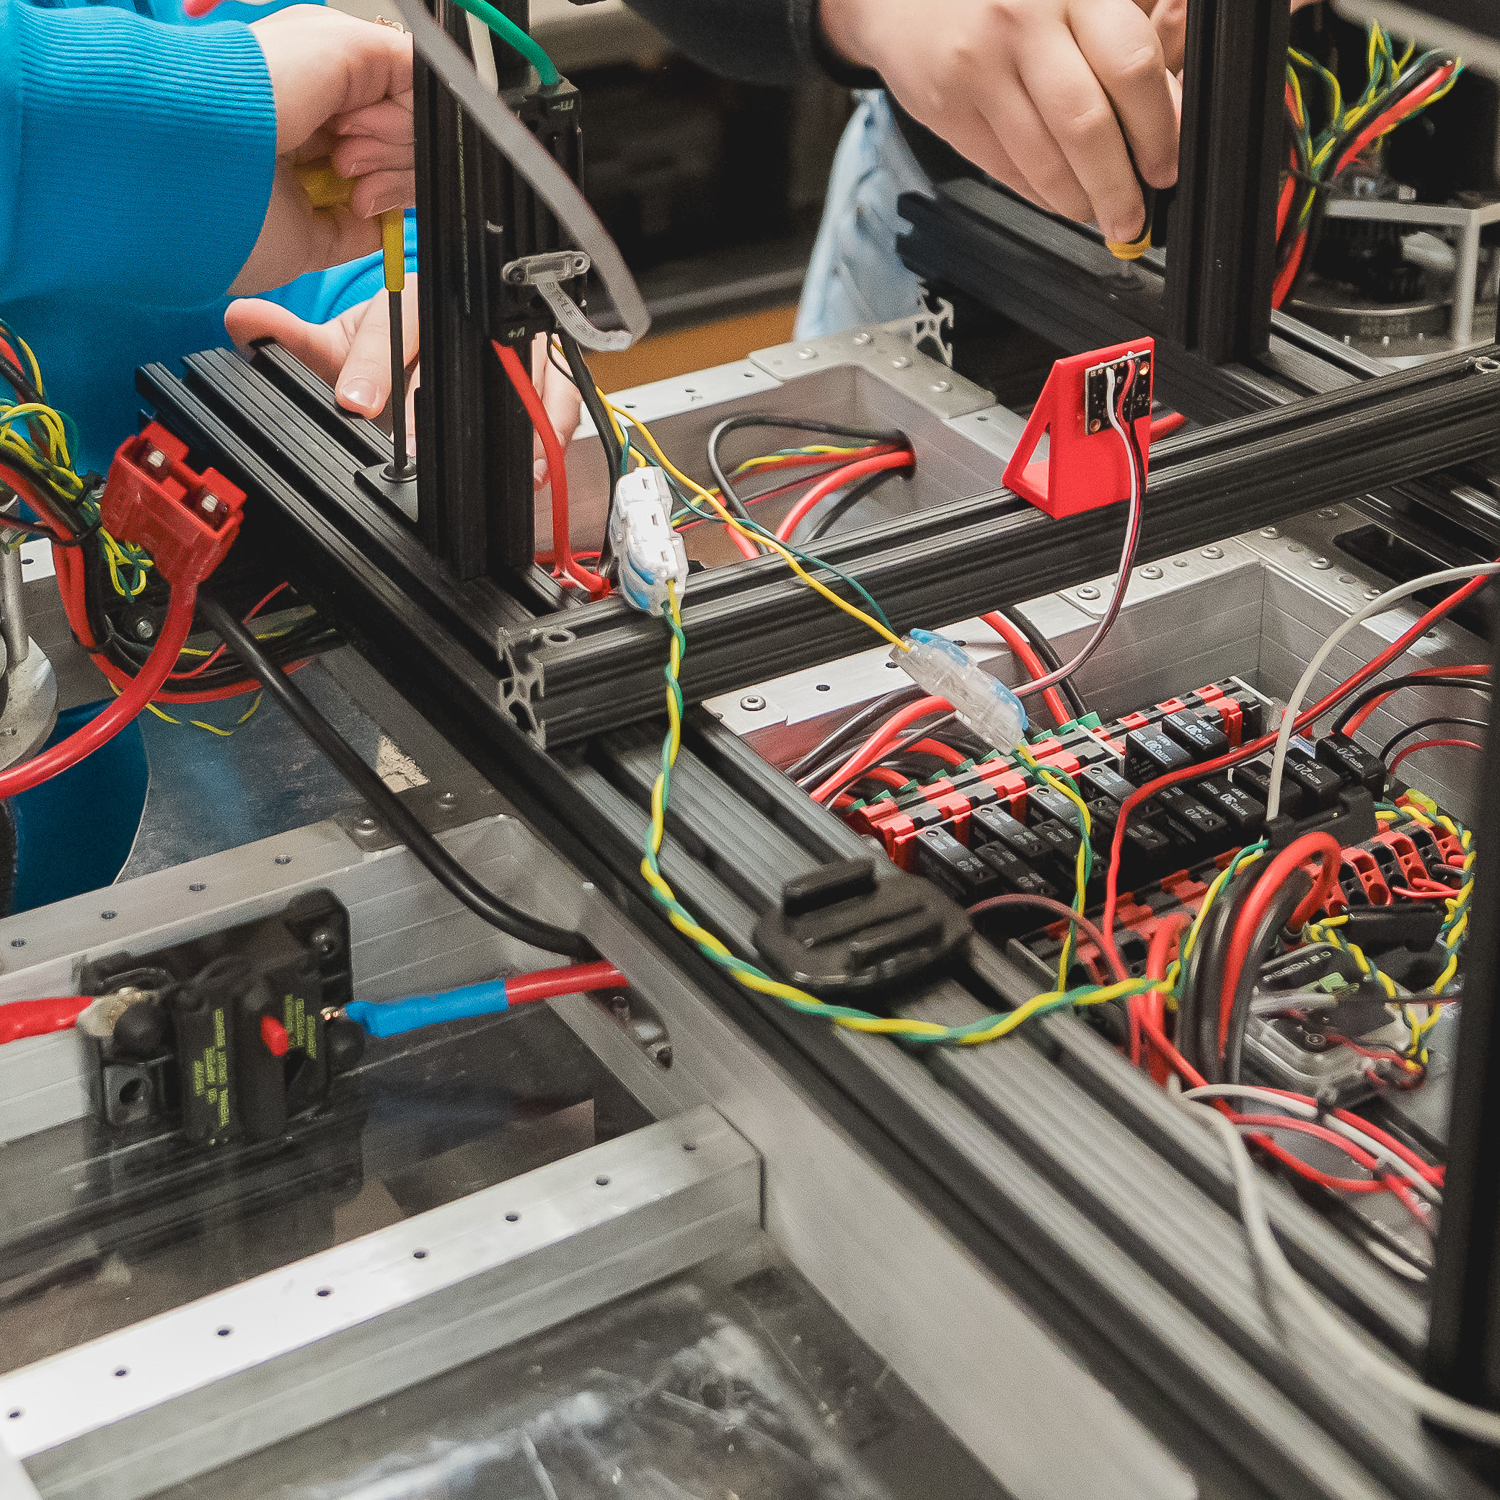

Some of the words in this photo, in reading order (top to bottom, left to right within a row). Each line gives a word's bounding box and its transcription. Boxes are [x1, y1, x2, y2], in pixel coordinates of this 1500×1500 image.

[1185, 724, 1202, 738] 30
[1144, 740, 1162, 751] 30
[1197, 733, 1213, 745] AUTO
[1156, 749, 1173, 762] AUTO
[1336, 748, 1353, 760] 20
[1294, 762, 1309, 775] 20
[1307, 773, 1322, 785] AUTO
[1219, 793, 1237, 806] 30
[1232, 803, 1248, 816] AUTO
[1263, 959, 1310, 982] PIGEON
[214, 1008, 226, 1048] BREAKER
[295, 998, 305, 1048] PROTECTED
[217, 1050, 228, 1084] CIRCUIT
[218, 1086, 230, 1127] THERMAL
